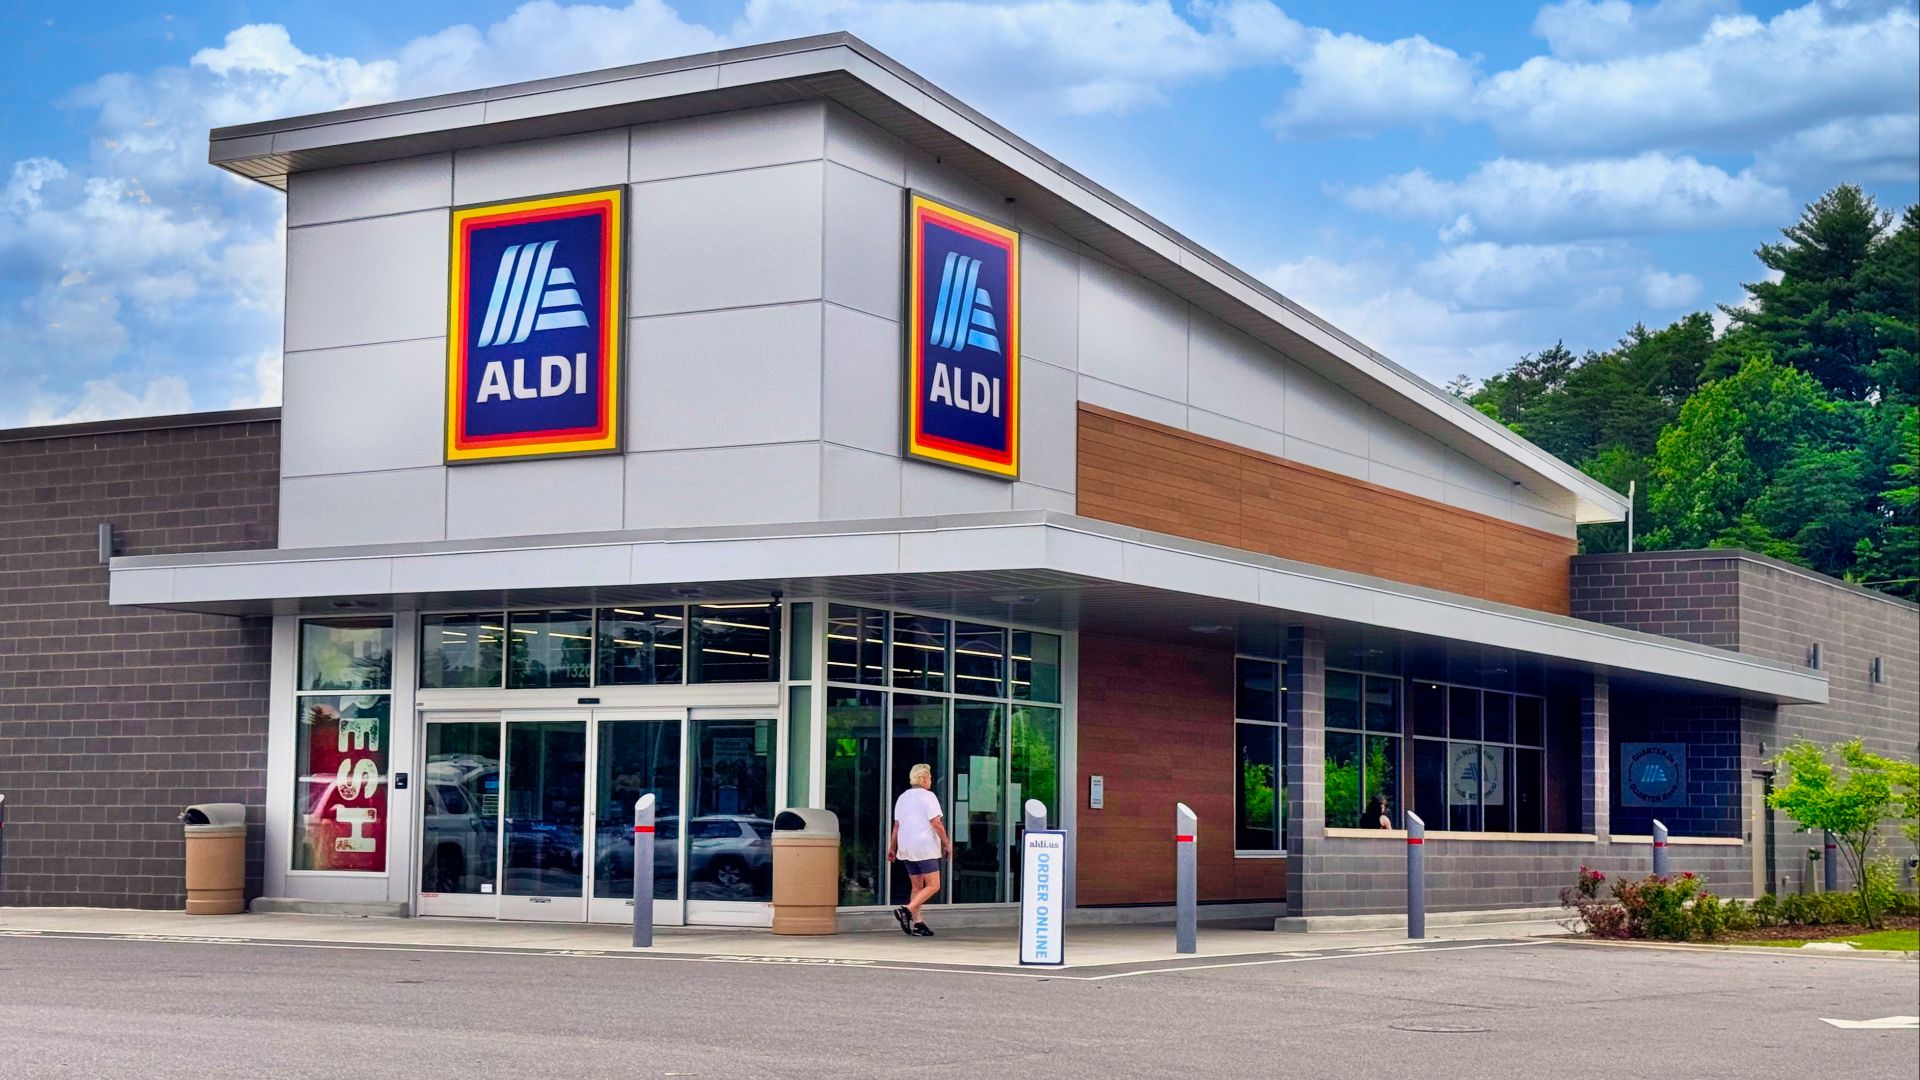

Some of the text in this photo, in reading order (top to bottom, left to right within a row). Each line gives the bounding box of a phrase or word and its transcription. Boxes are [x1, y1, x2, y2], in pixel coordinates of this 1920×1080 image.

[476, 353, 587, 403] ALDI
[930, 362, 1000, 418] ALDI
[335, 628, 382, 853] FRESH
[1029, 839, 1059, 849] aldi.us
[1035, 853, 1050, 959] ORDER ONLINE
